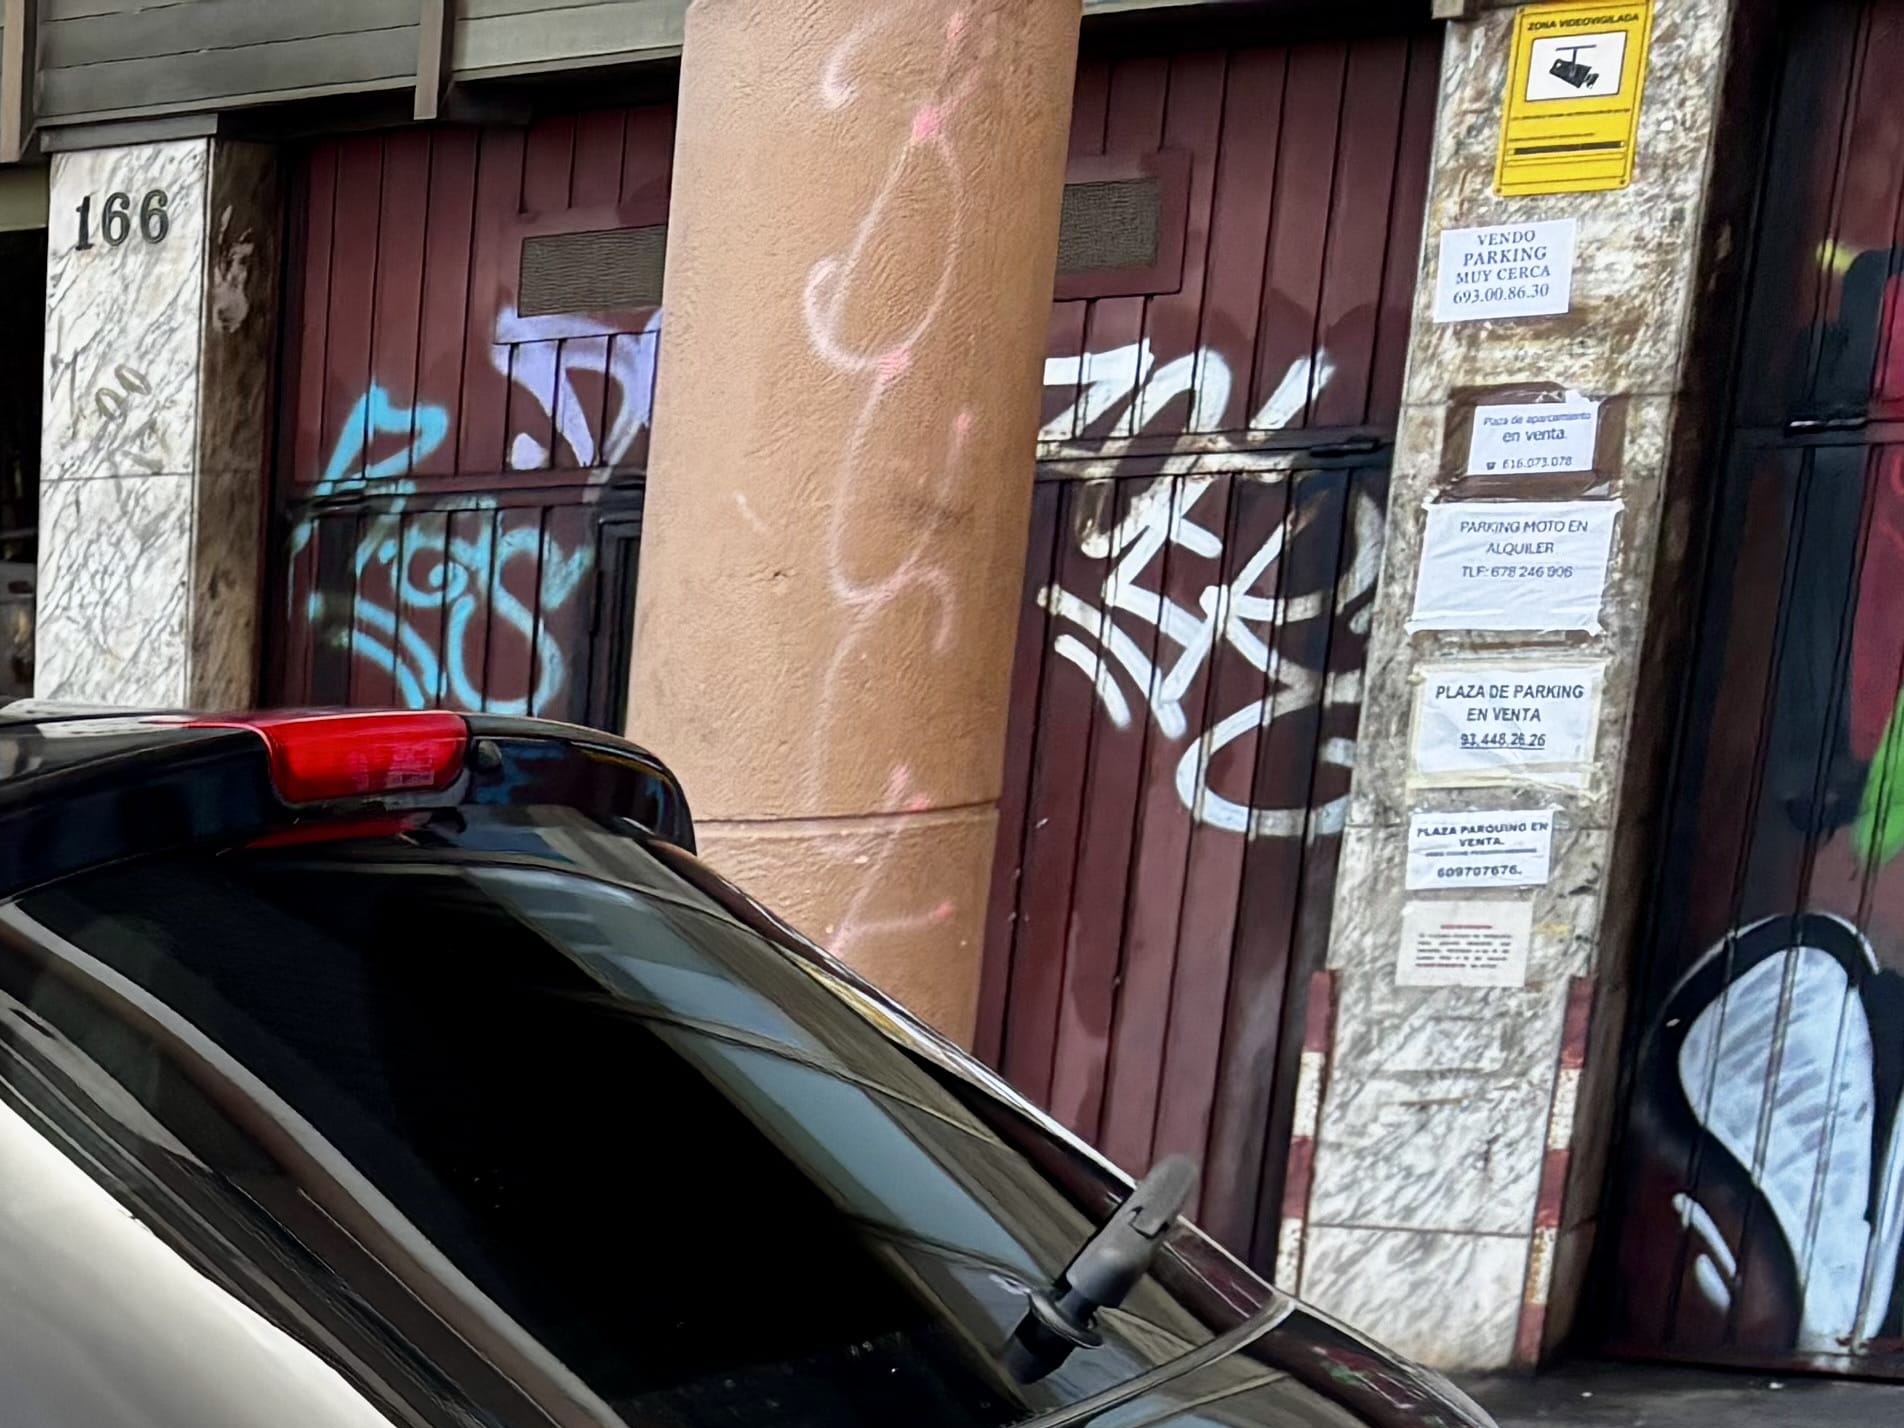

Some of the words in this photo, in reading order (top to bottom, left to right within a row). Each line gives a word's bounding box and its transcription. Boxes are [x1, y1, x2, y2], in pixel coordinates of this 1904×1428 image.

[1527, 20, 1556, 31] ZONA
[1560, 13, 1639, 27] VIDEOVIGILADA
[75, 189, 169, 251] 166
[1478, 230, 1536, 246] VENDO
[1463, 246, 1547, 266] PARKING
[1456, 270, 1492, 285] MUY
[1496, 265, 1551, 281] CERCA
[1453, 283, 1550, 304] 693.00.86.30
[1502, 431, 1521, 442] en
[1460, 521, 1520, 534] PARKING
[1523, 520, 1565, 533] MOTO
[1568, 519, 1588, 532] EN
[1486, 542, 1554, 556] ALQUILER
[1435, 685, 1485, 699] PLAZA
[1489, 684, 1510, 699] DE
[1513, 684, 1585, 699] PARKING
[1466, 707, 1488, 722] EN
[1492, 707, 1542, 722] VENTA
[1530, 822, 1549, 832] EN
